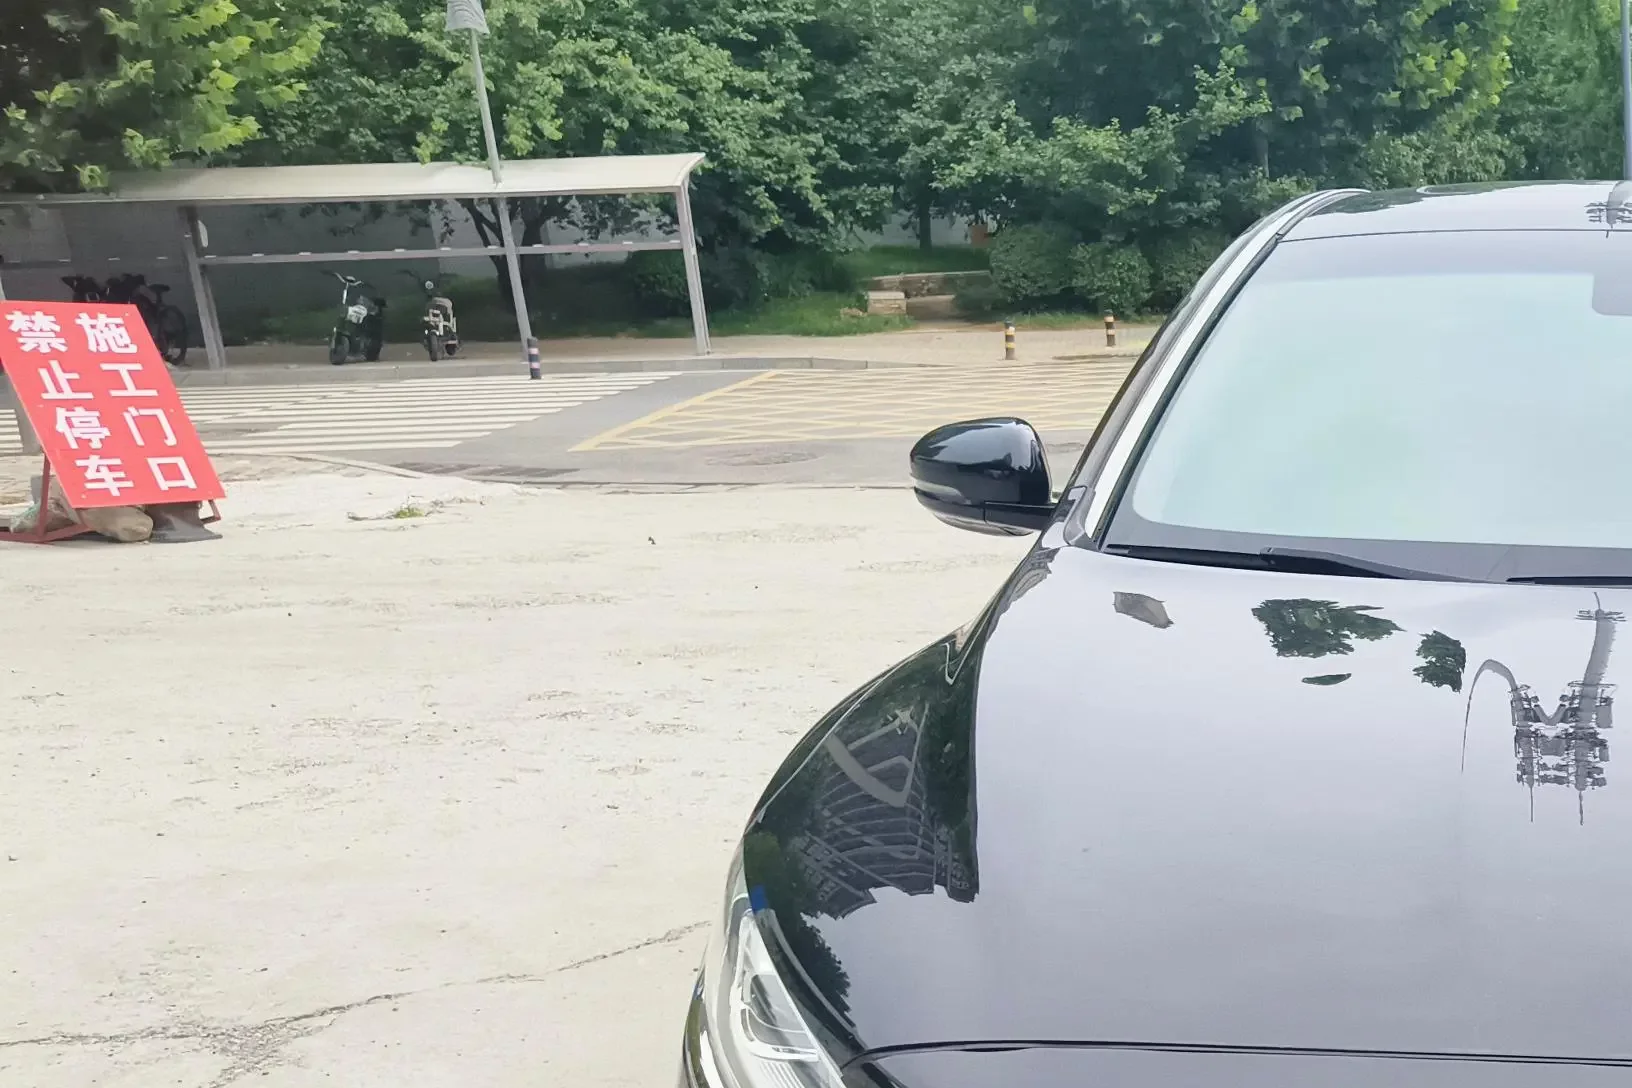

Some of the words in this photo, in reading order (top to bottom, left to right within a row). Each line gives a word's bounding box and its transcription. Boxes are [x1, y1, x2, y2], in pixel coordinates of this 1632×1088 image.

[5, 310, 135, 497] 禁止停车
[75, 312, 198, 491] 施工门口
